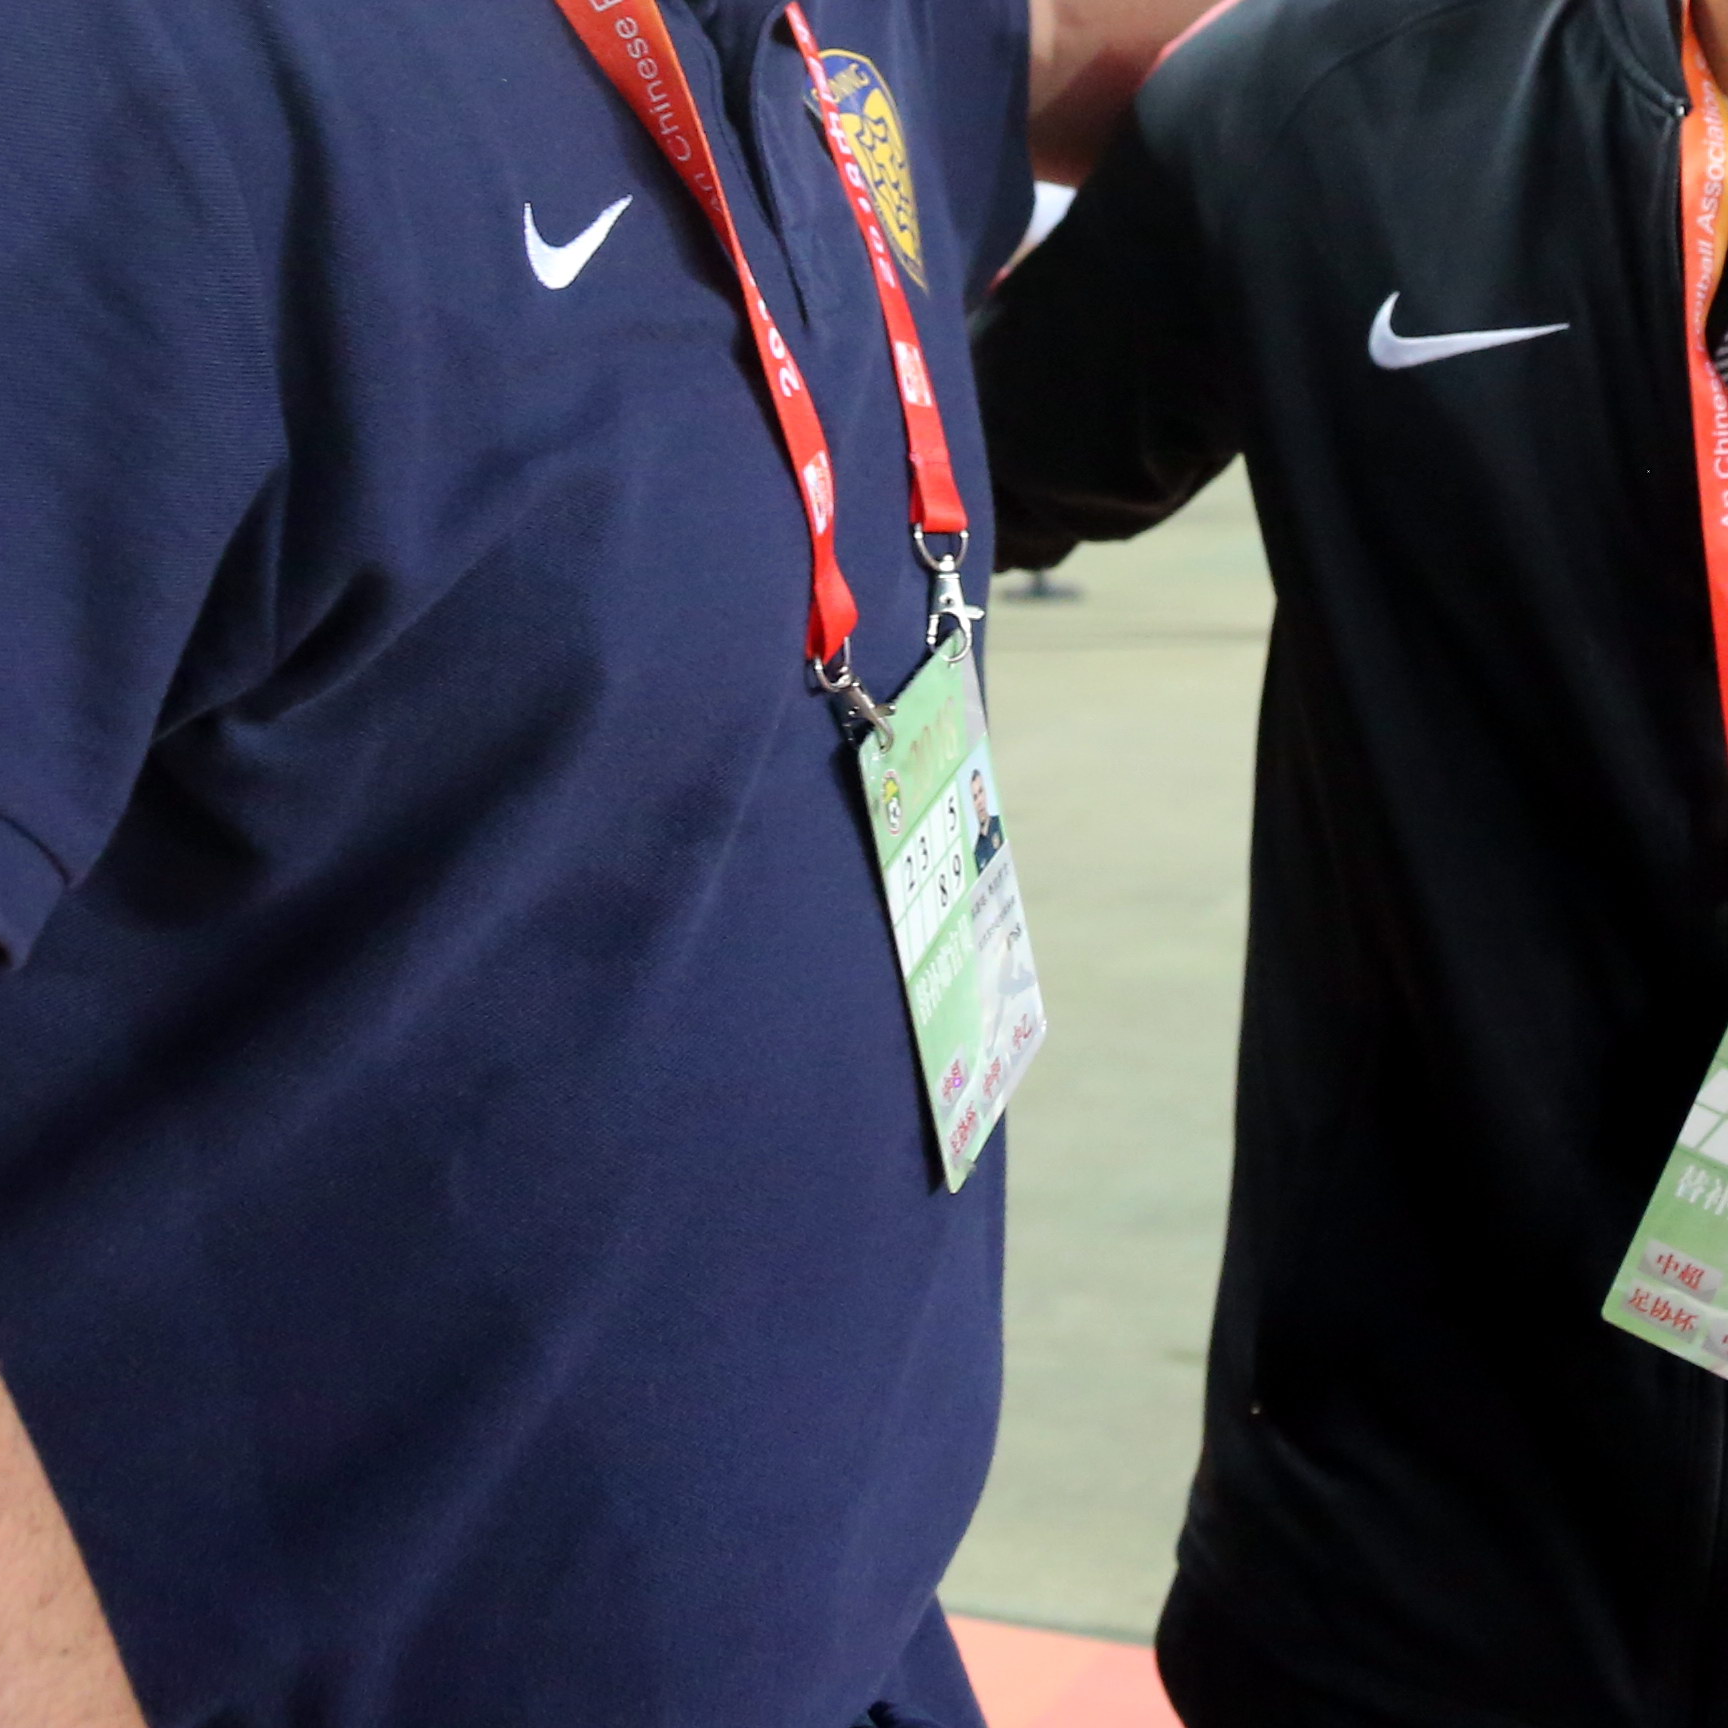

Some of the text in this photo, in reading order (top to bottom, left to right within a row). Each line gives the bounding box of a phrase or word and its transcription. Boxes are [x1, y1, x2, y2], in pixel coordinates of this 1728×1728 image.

[614, 17, 694, 162] Chinese
[905, 855, 915, 892] 2
[948, 796, 957, 832] 5
[938, 853, 962, 908] 8 9
[1656, 1253, 1706, 1291] 中超
[1628, 1287, 1701, 1333] 足协杯
